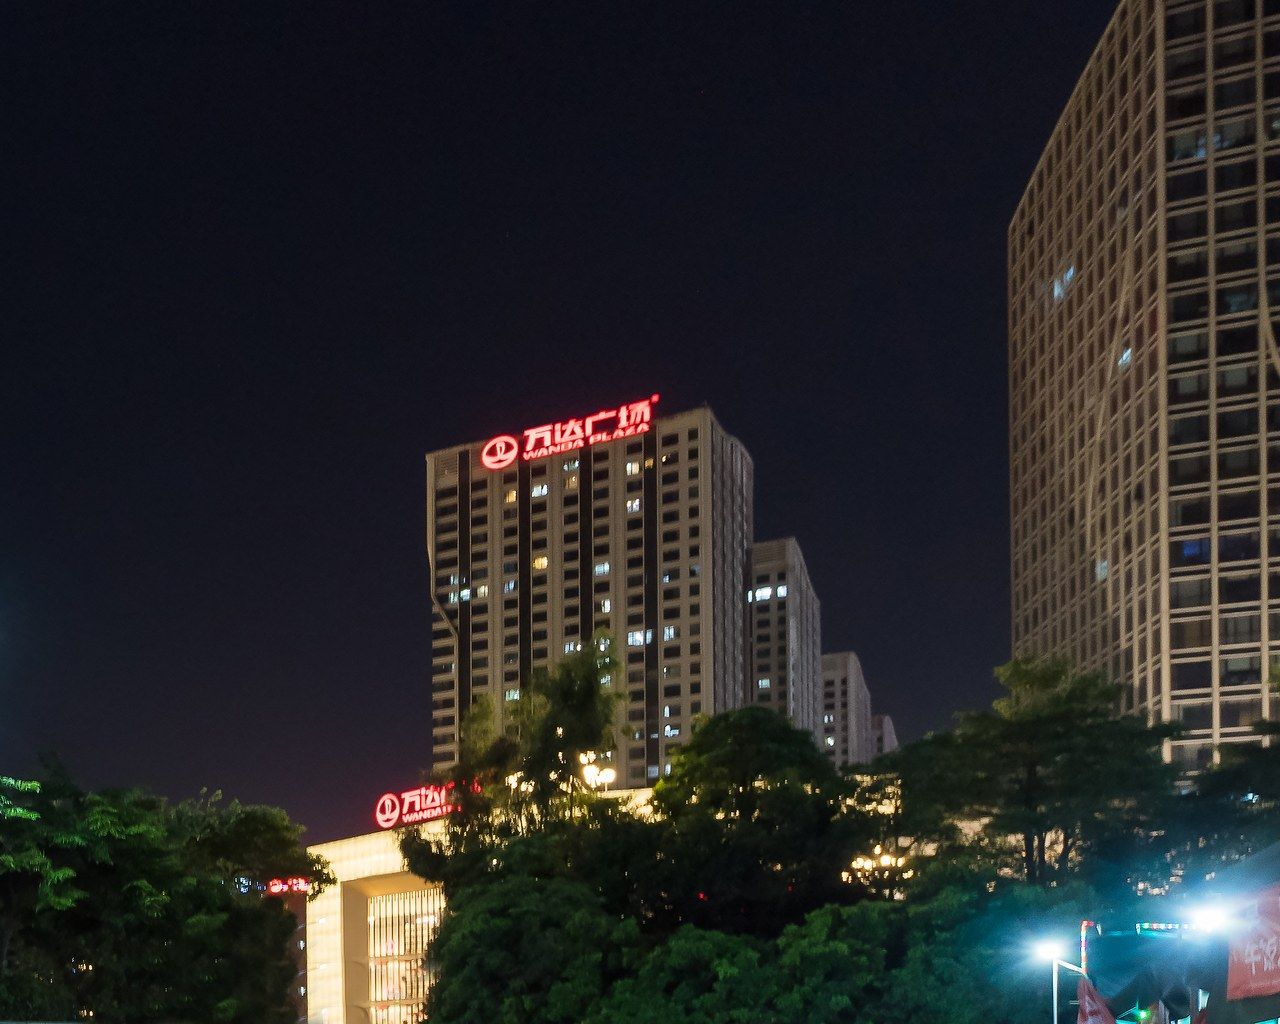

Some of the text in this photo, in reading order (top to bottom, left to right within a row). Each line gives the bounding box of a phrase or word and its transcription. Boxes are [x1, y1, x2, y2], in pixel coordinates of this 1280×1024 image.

[523, 399, 651, 451] 万达广场
[523, 422, 650, 460] WANDA PLAZA
